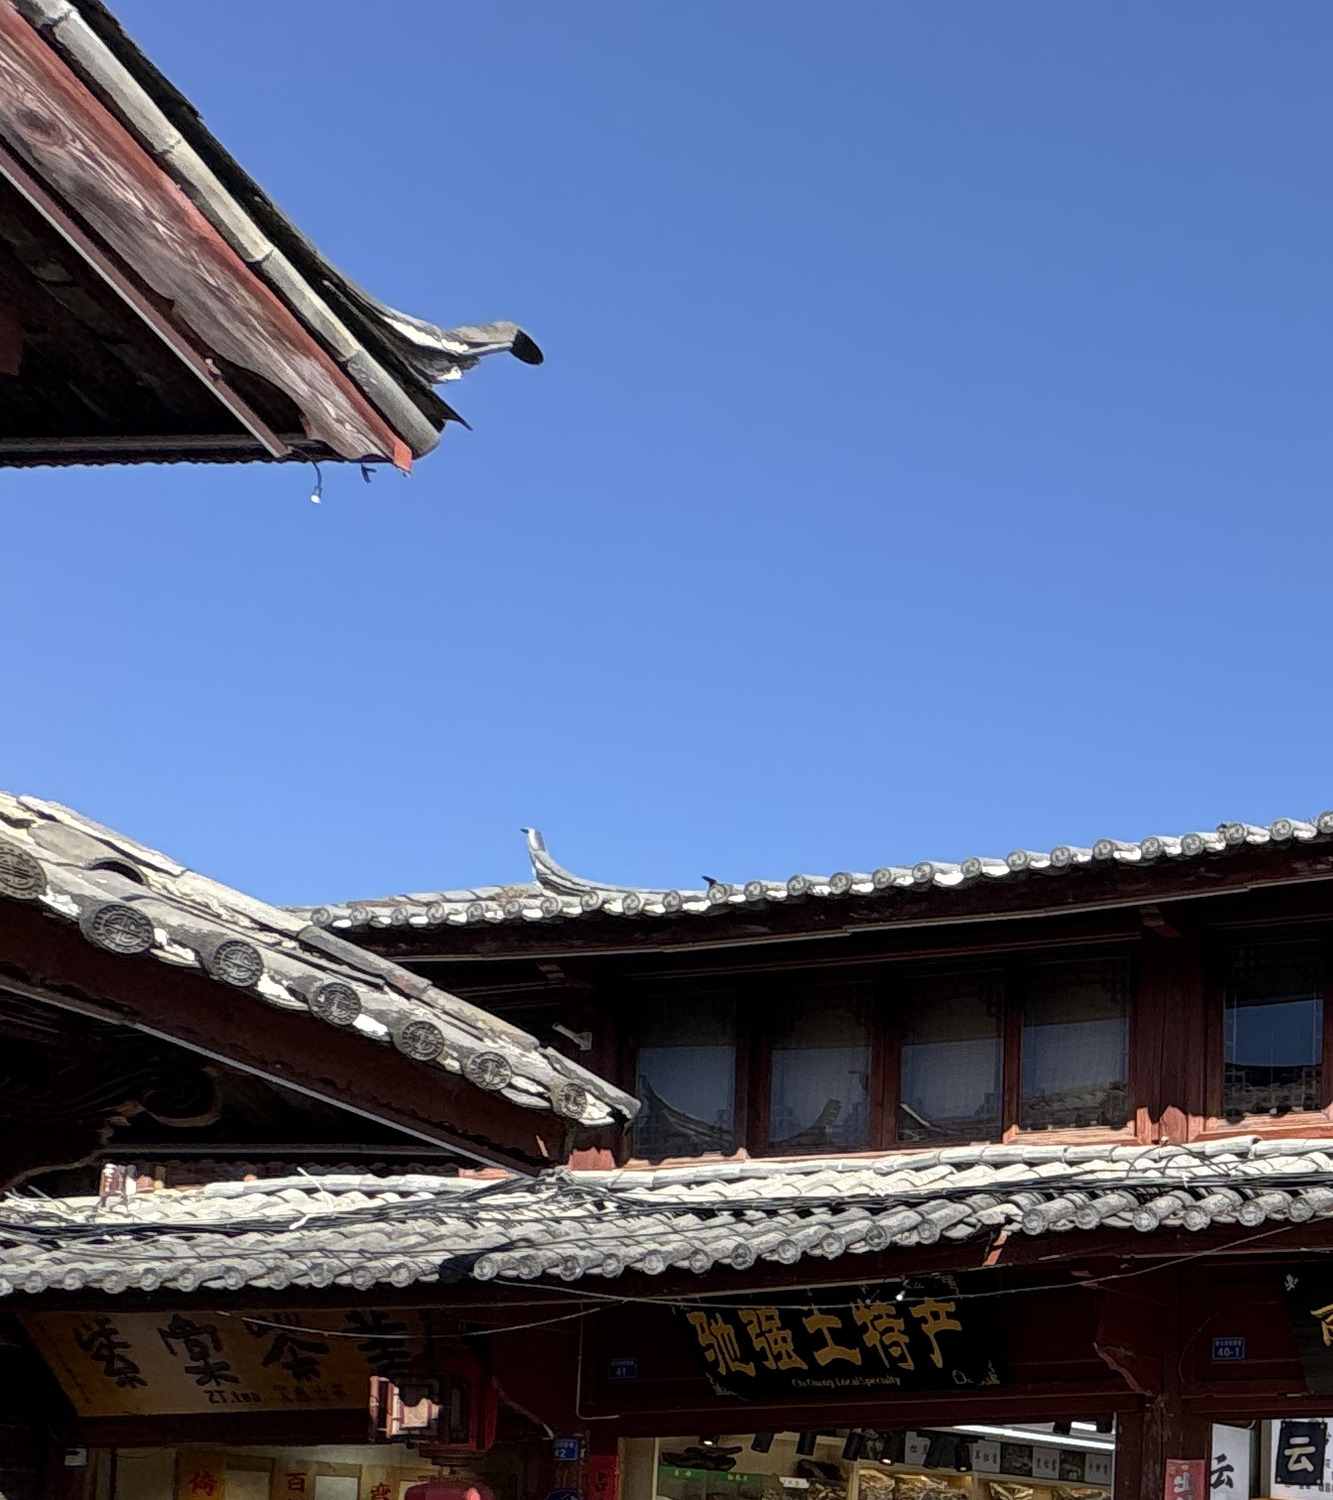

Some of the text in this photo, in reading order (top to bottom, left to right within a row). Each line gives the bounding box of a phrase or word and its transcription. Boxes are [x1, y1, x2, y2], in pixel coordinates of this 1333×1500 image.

[684, 1296, 964, 1378] 驰强土特产
[1217, 1346, 1240, 1358] 40-1
